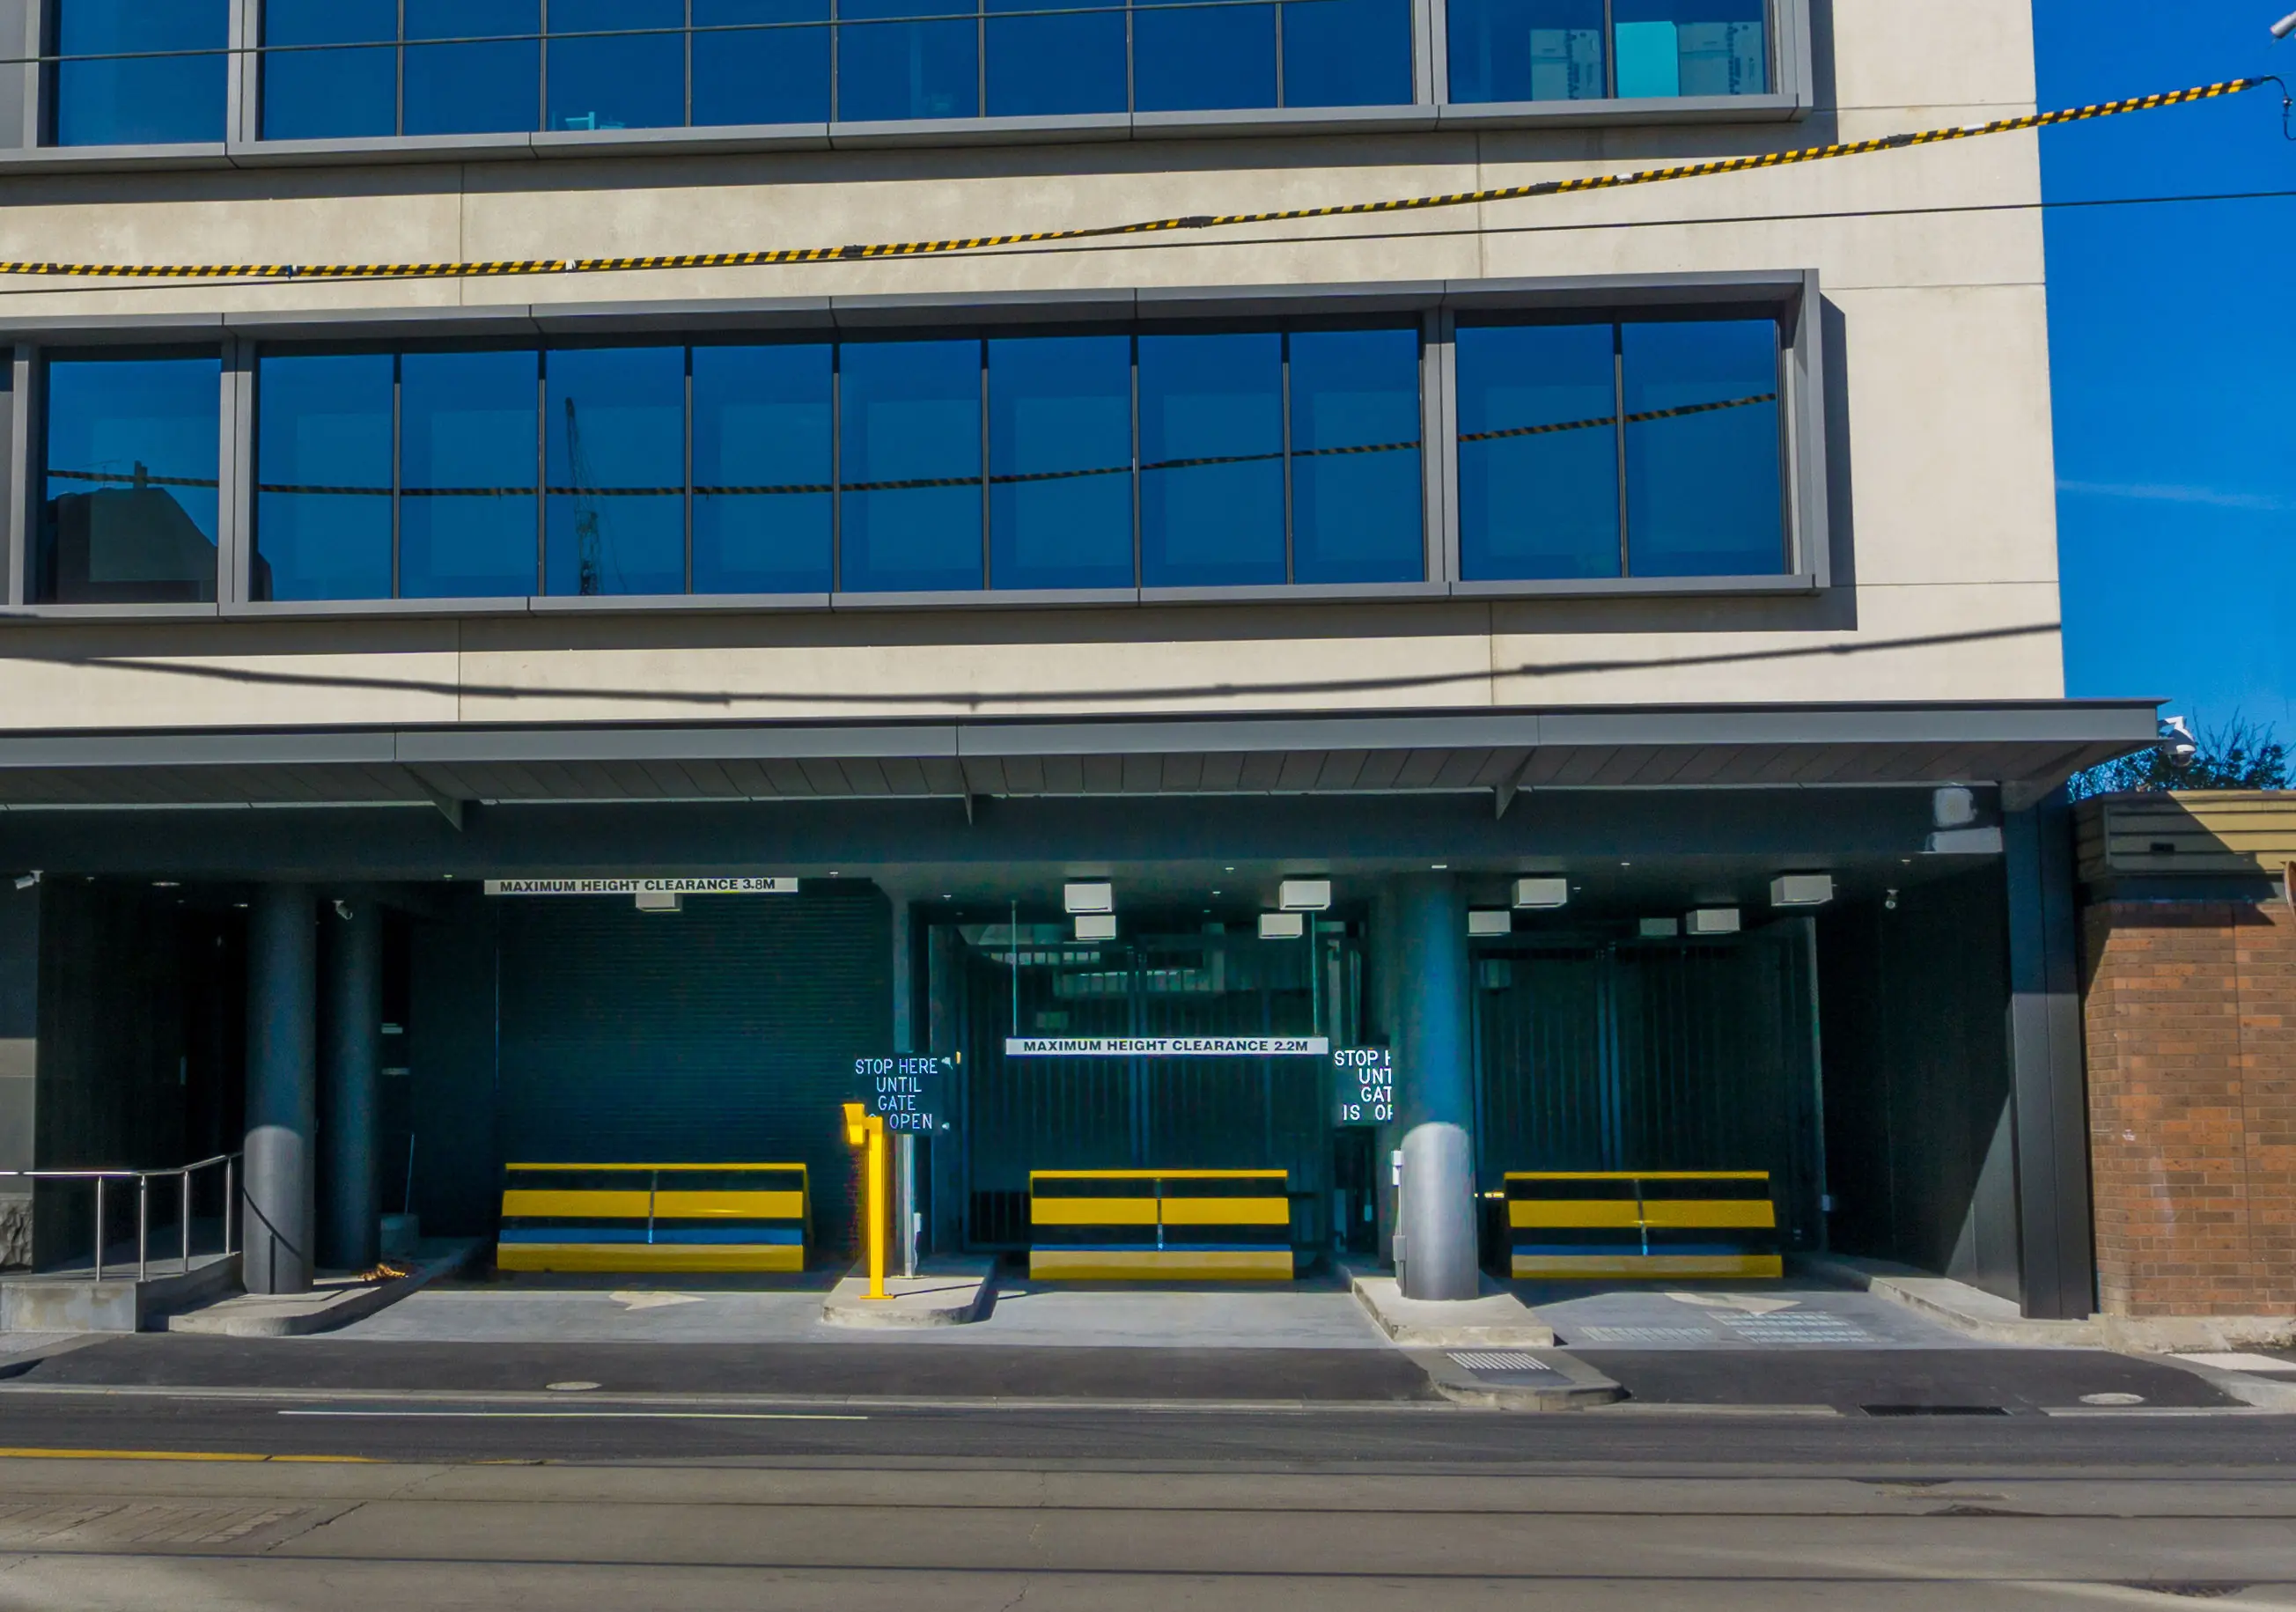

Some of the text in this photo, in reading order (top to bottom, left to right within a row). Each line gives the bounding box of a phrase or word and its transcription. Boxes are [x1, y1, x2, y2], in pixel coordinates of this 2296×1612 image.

[499, 878, 776, 893] MAXIMUM HEIGHT CLEARANCE 3.8M
[1024, 1040, 1308, 1051] MAXIMUM HEIGHT CLEARANCE 2.2M
[855, 1057, 938, 1074] STOP HERE
[1334, 1049, 1379, 1066] STOP
[876, 1076, 923, 1093] UNTIL
[1358, 1067, 1392, 1085] UNT
[878, 1094, 916, 1111] GATE
[1360, 1086, 1393, 1103] GAT
[889, 1112, 932, 1130] OPEN
[1341, 1104, 1361, 1121] IS
